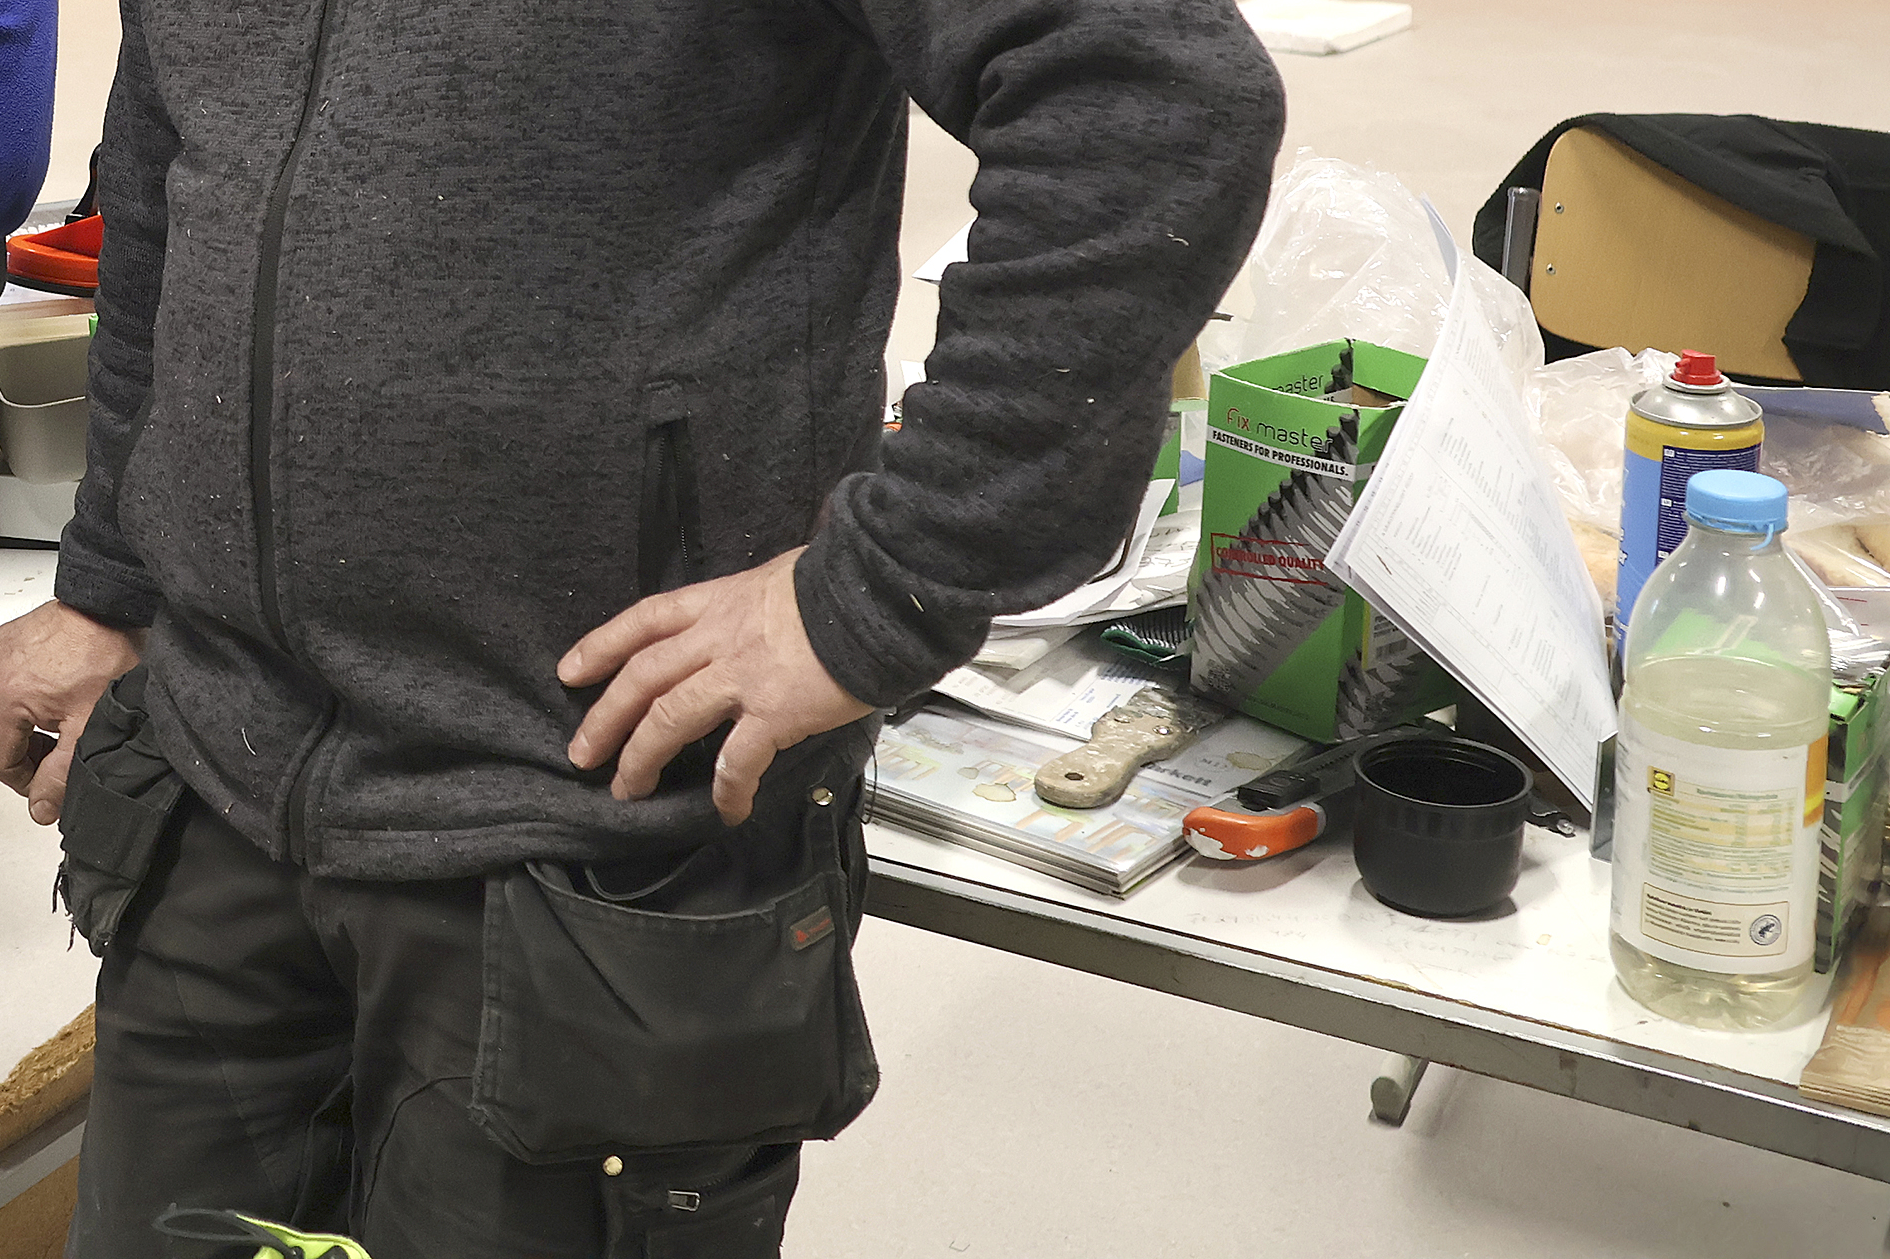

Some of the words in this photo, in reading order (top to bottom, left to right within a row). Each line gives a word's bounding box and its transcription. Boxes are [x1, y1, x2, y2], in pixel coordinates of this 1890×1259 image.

[1212, 430, 1254, 453] FASTENERS
[1254, 442, 1270, 458] FOR
[1271, 450, 1349, 477] PROFESSIONALS.
[1256, 421, 1334, 454] master
